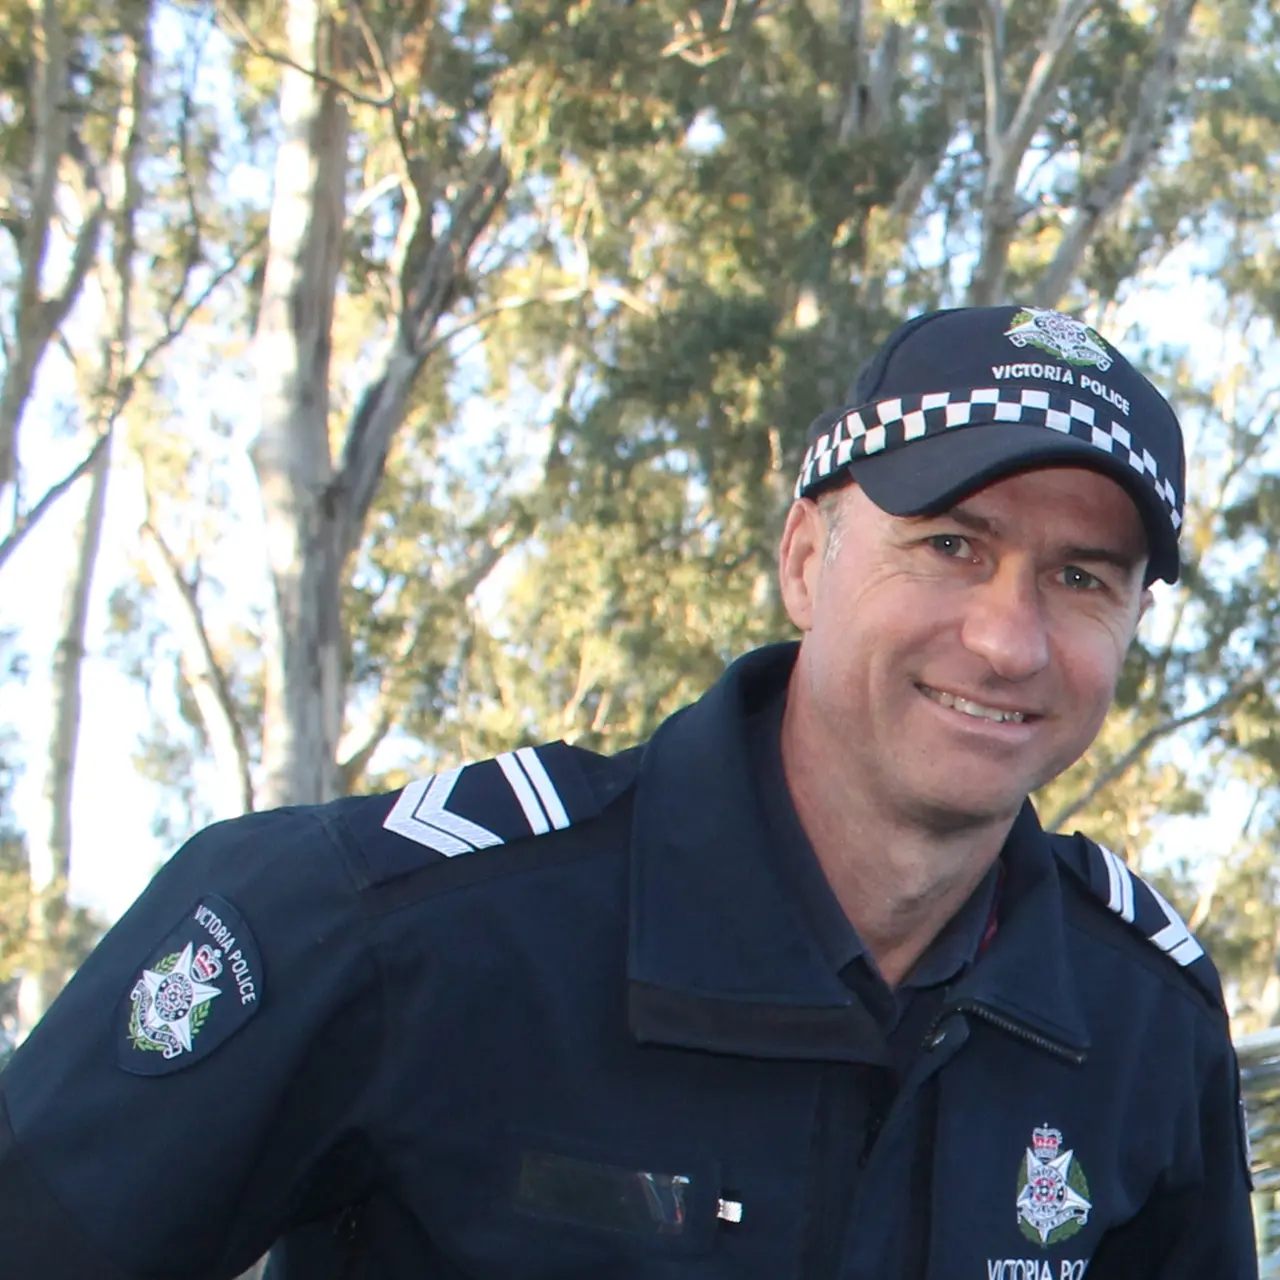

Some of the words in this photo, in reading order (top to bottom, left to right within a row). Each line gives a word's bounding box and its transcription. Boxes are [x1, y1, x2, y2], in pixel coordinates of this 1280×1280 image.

[991, 363, 1074, 385] VICTORIA
[1080, 374, 1131, 416] POLICE
[194, 904, 236, 954] VICTORIA
[227, 949, 256, 1005] POLICE
